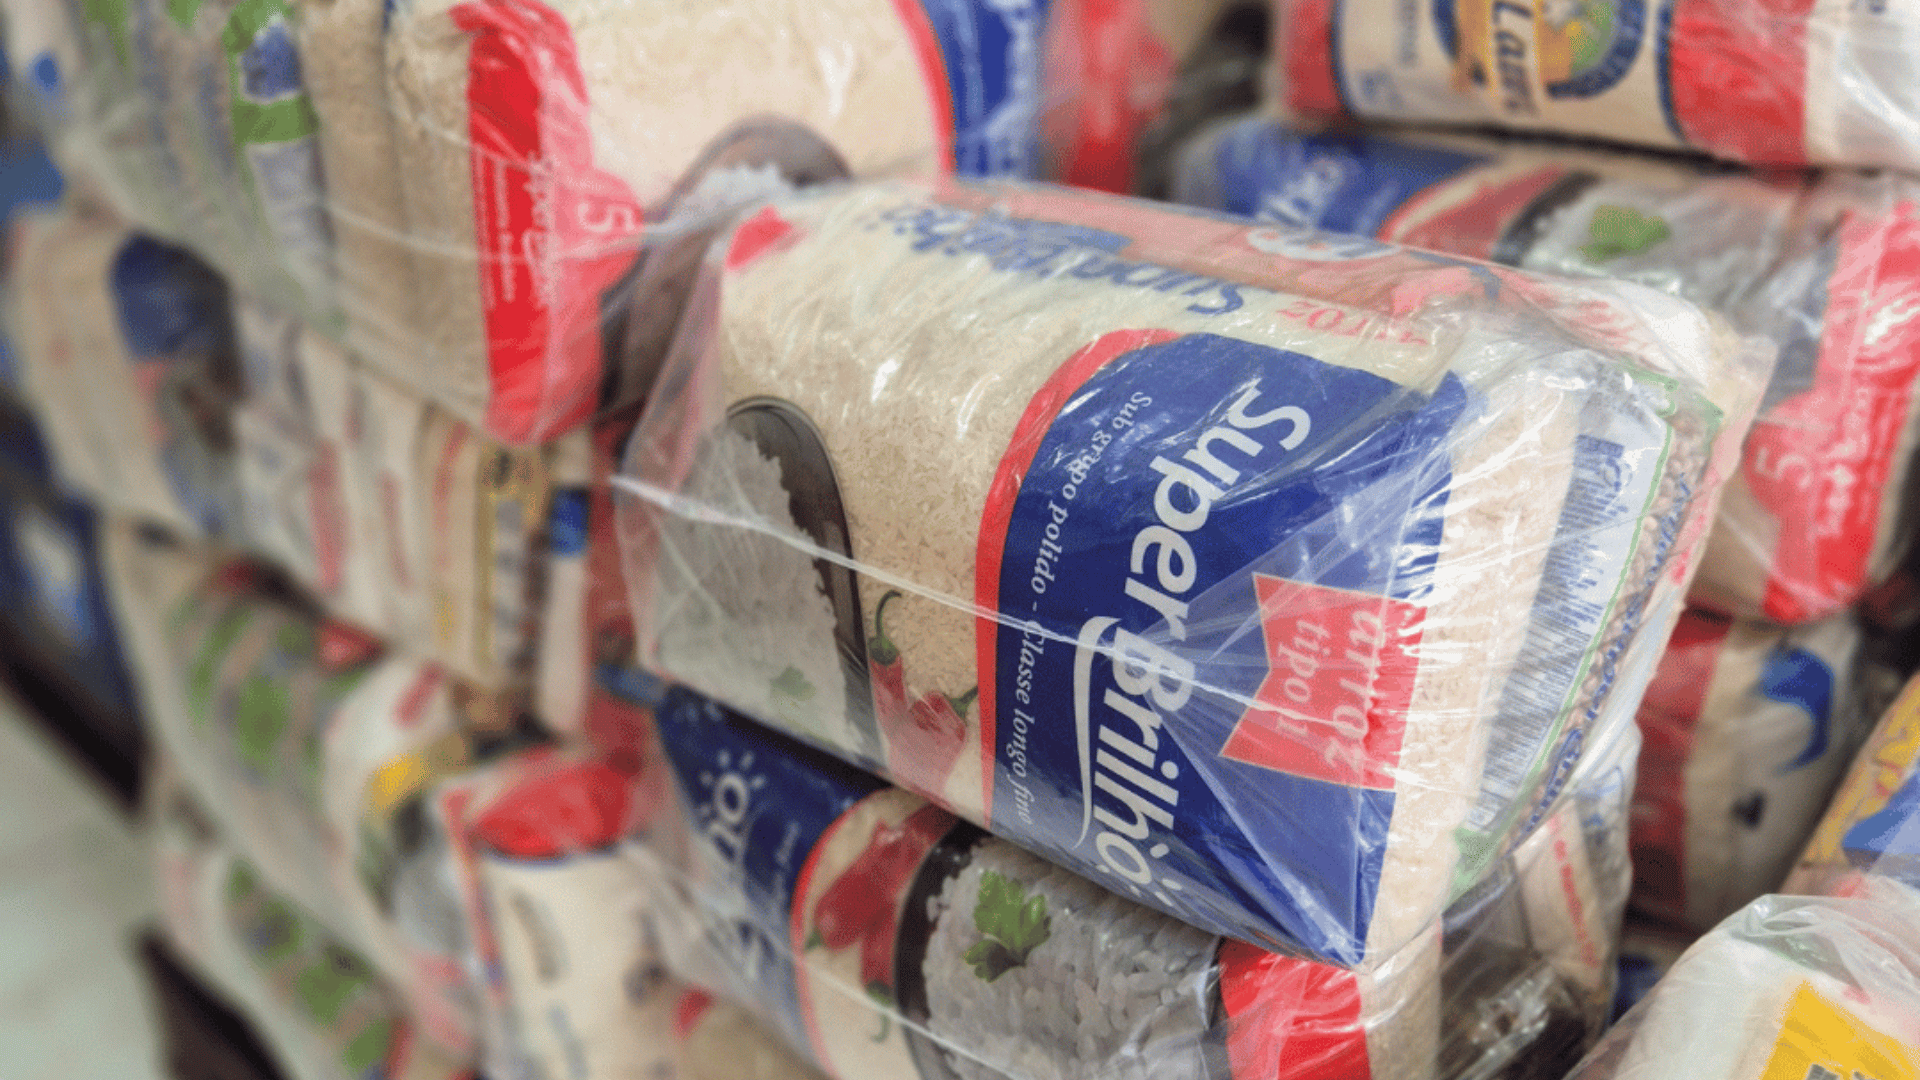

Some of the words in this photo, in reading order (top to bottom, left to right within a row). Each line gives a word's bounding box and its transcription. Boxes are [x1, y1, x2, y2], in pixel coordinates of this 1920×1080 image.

[577, 203, 637, 233] 5
[1112, 391, 1153, 430] Sub
[1063, 429, 1112, 500] grupo
[1031, 500, 1068, 594] polido
[1016, 620, 1044, 705] Classe
[1277, 619, 1330, 703] tipo
[1323, 611, 1386, 774] arroz
[1006, 708, 1035, 777] longo
